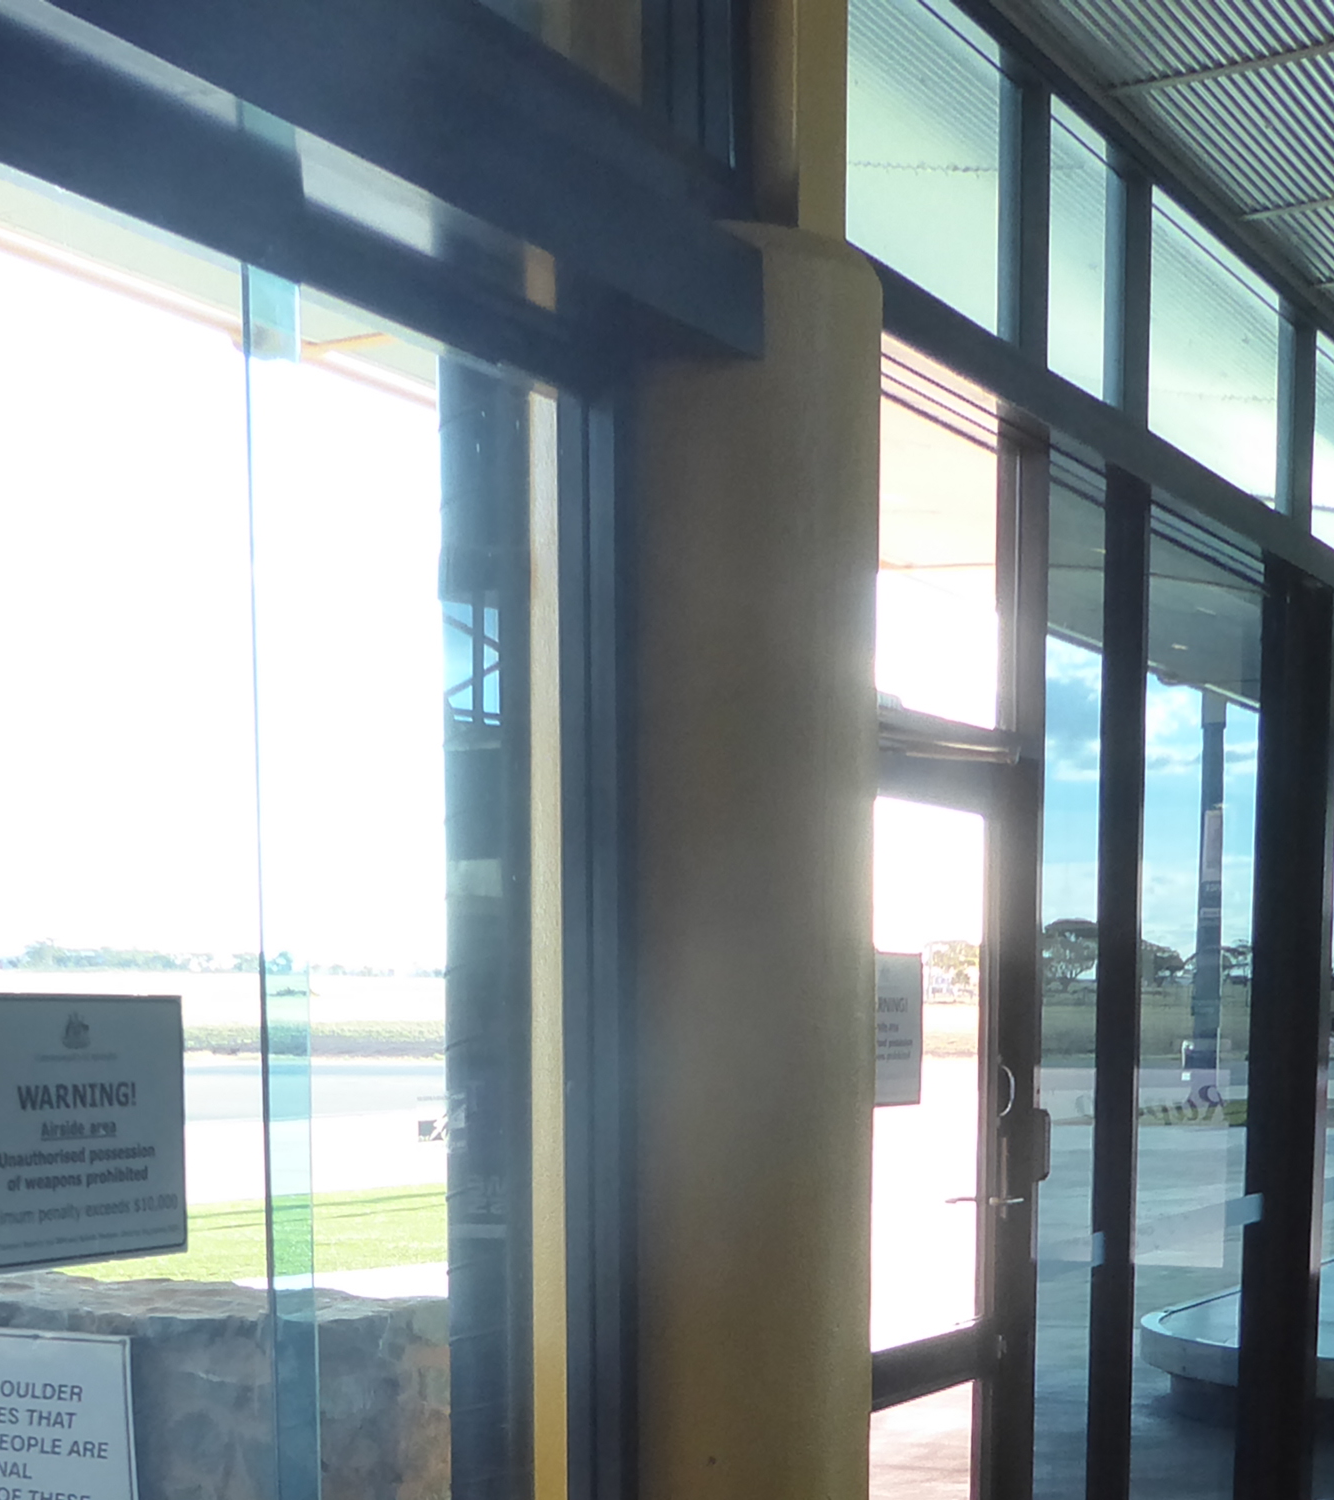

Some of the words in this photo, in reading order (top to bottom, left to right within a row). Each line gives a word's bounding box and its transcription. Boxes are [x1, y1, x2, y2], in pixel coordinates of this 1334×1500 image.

[18, 1081, 137, 1111] WARNING!
[41, 1120, 86, 1139] Airside
[90, 1121, 117, 1136] area
[89, 1145, 156, 1166] possession
[7, 1176, 21, 1192] of
[25, 1173, 82, 1191] weapons
[86, 1165, 149, 1188] prohibited
[39, 1203, 82, 1223] penalty
[85, 1198, 130, 1217] exceeds
[26, 1409, 77, 1430] THAT
[67, 1439, 109, 1460] ARE
